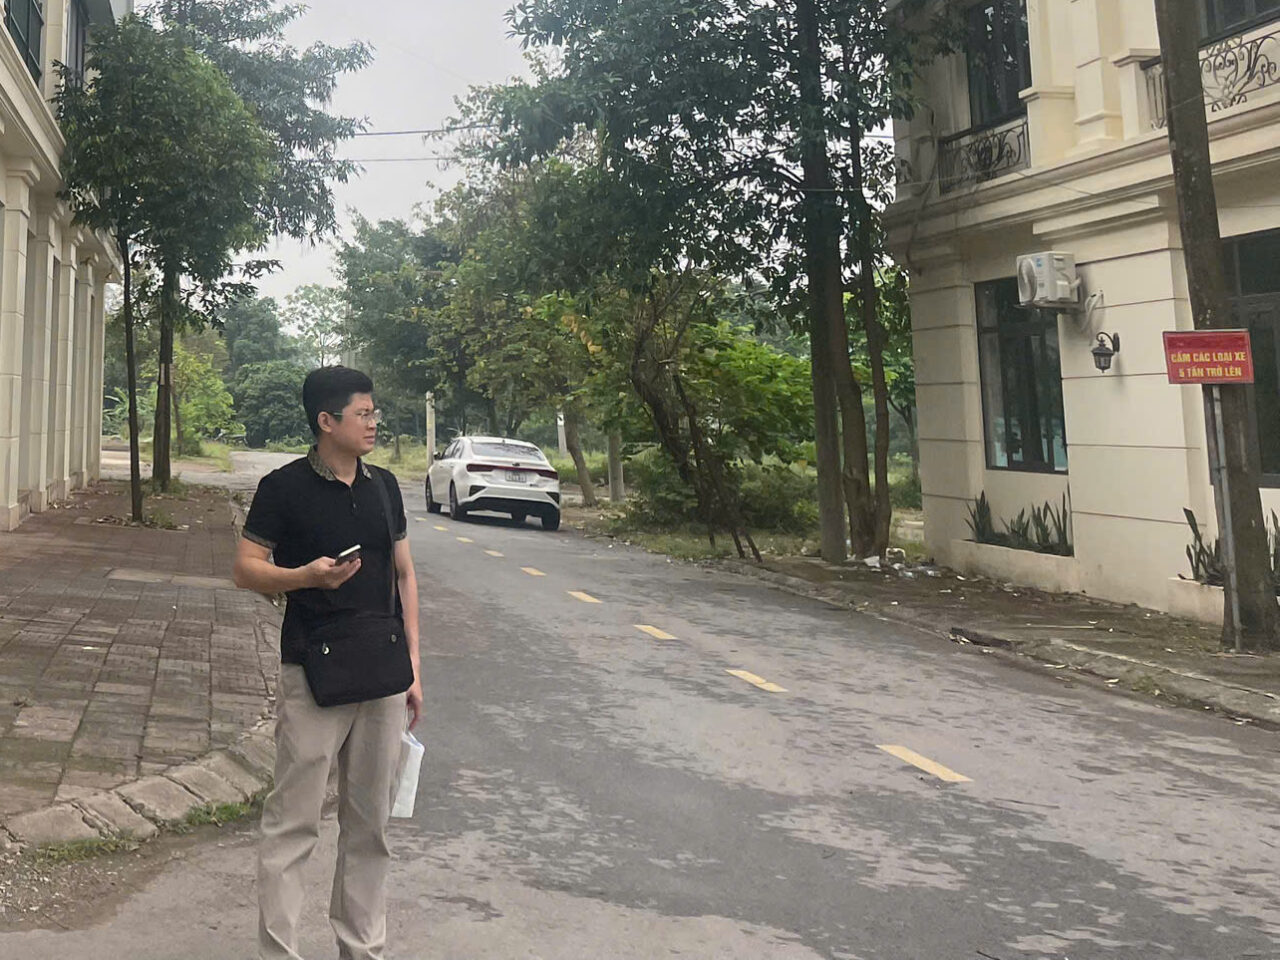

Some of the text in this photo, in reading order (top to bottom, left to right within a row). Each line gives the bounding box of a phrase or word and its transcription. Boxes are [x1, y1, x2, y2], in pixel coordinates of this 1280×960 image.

[1171, 351, 1246, 363] CẤM CÁC LOẠI XE
[1186, 364, 1204, 377] TẤN
[1205, 364, 1223, 377] TRỞ
[1224, 365, 1242, 377] LÊN
